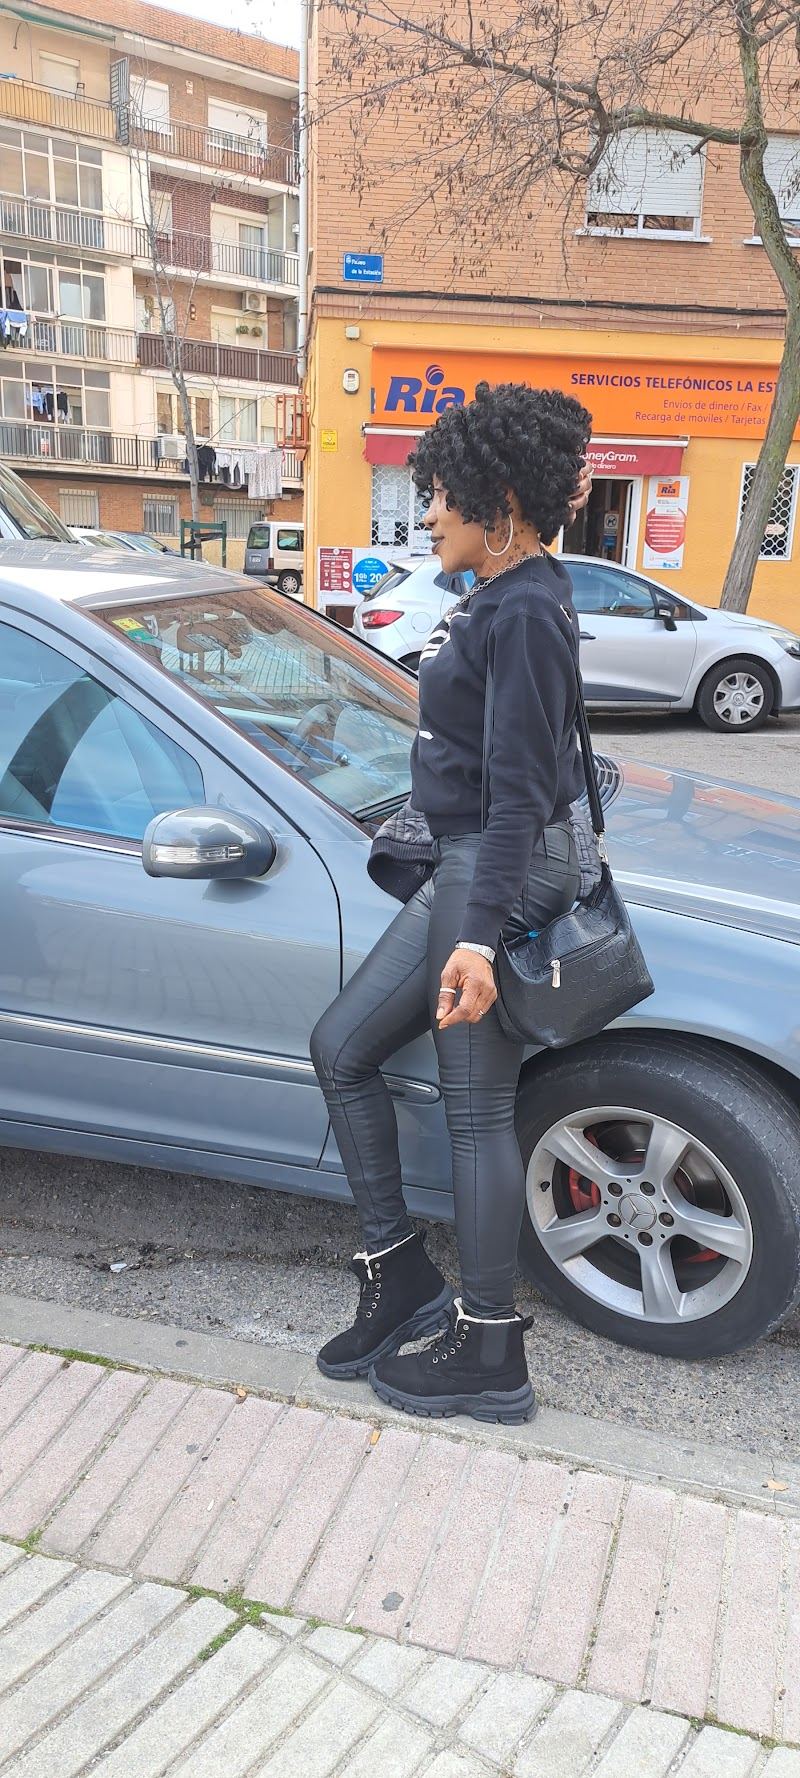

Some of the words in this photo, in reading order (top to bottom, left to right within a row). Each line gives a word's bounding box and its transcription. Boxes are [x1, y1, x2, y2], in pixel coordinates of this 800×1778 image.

[384, 365, 465, 414] Ria
[571, 373, 641, 388] SERVICIOS
[645, 376, 732, 392] TELEFÓNICOS
[737, 381, 753, 392] LA
[695, 401, 706, 410] de
[709, 401, 738, 411] dinero
[747, 403, 762, 412] Fax
[635, 411, 671, 423] Recarga
[674, 412, 686, 422] de
[731, 415, 766, 426] Tarjetas
[661, 484, 676, 494] Ria
